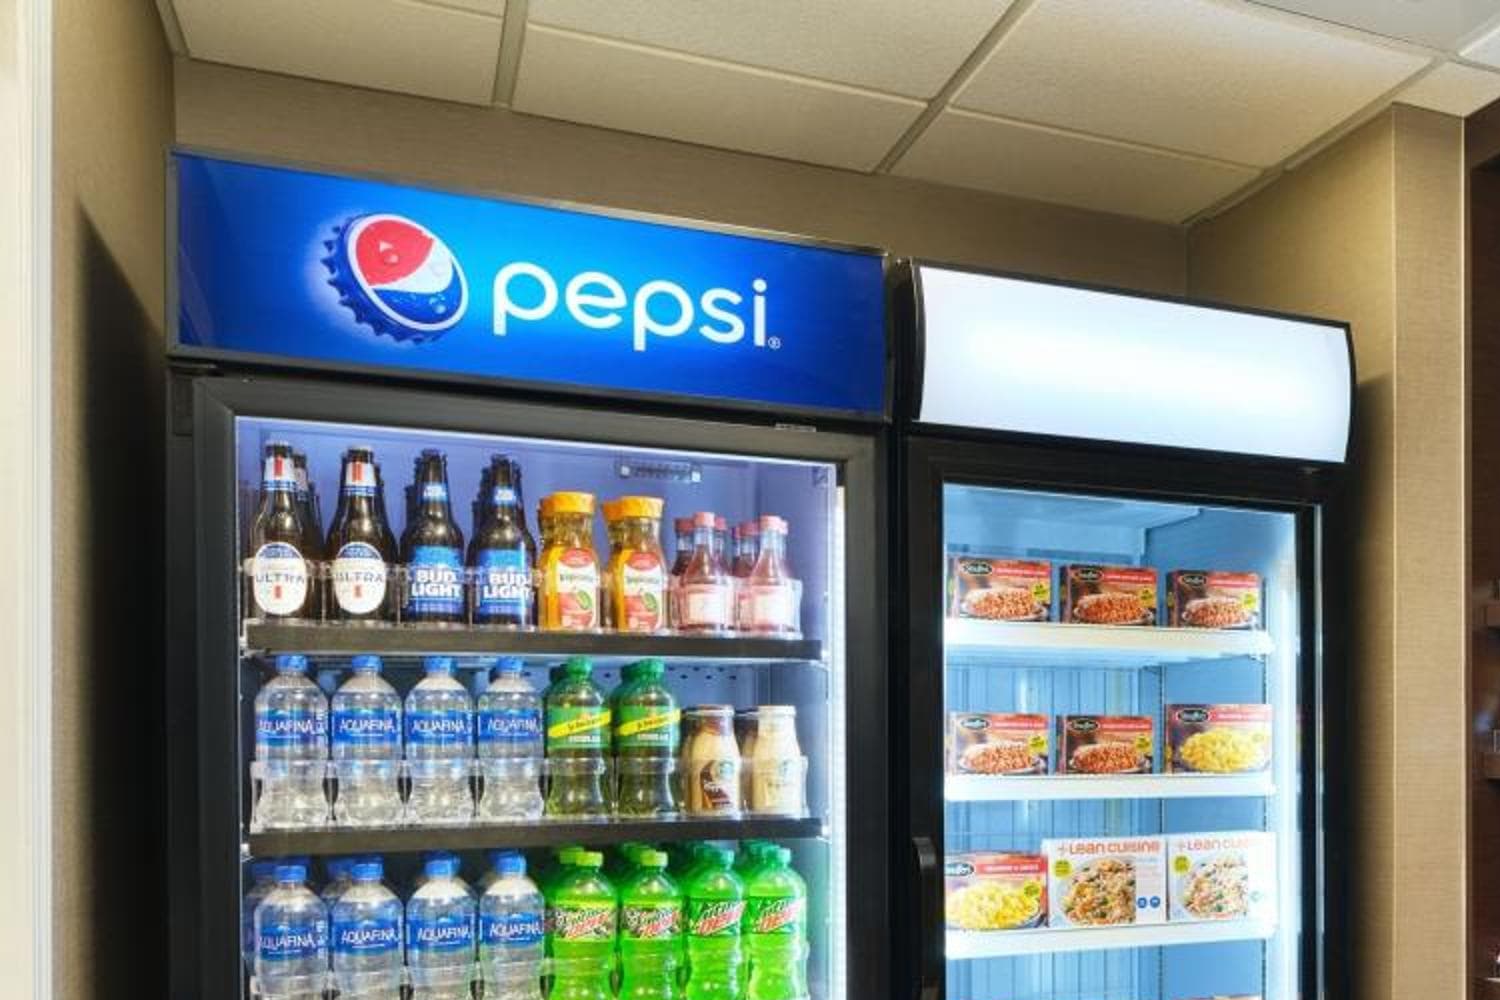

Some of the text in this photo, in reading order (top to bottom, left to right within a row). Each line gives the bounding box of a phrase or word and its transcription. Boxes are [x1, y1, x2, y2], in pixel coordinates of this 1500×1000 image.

[492, 262, 767, 351] pepsi
[255, 573, 305, 584] ULTRA
[416, 569, 457, 582] BUD
[489, 572, 529, 585] BUD
[411, 582, 462, 598] LIGHT
[484, 584, 533, 599] LIGHT
[341, 926, 399, 943] AQUAFINA
[417, 924, 472, 941] AQUAFINA
